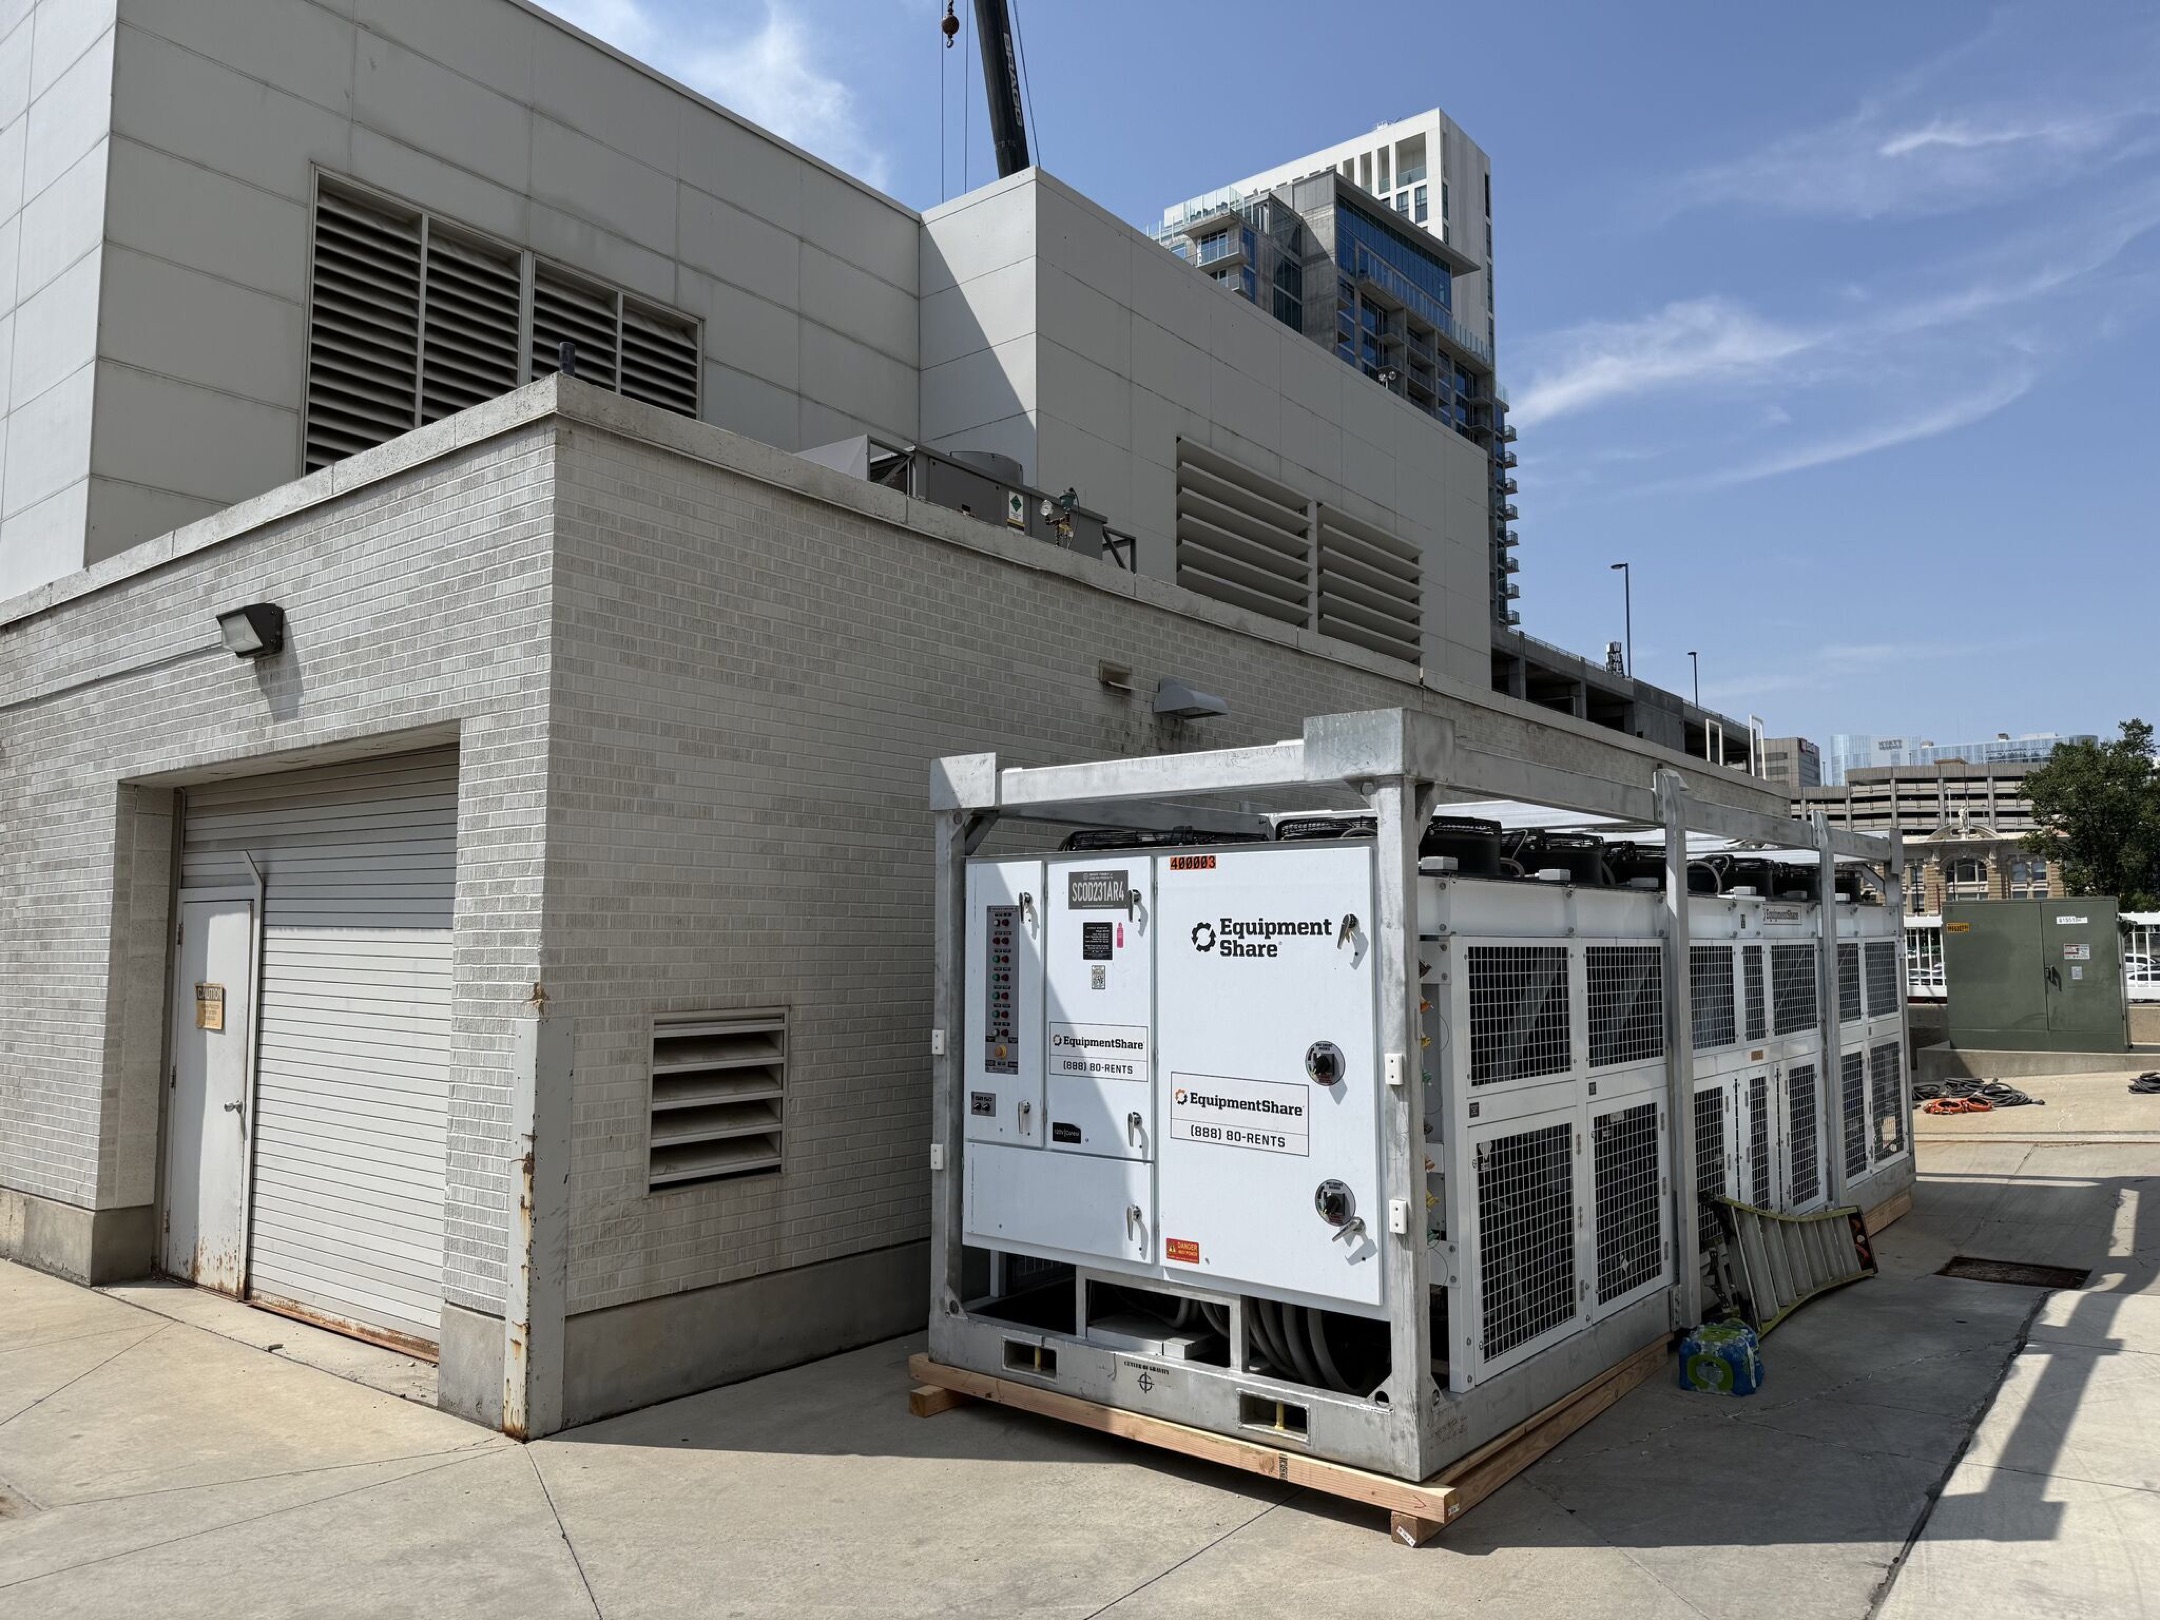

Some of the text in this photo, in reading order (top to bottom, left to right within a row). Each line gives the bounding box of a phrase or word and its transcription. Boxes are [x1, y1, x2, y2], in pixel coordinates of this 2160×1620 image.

[1003, 33, 1022, 127] BRAGG
[1170, 855, 1216, 869] 400003
[1220, 918, 1332, 939] Equipment
[1220, 940, 1278, 957] Share
[198, 987, 222, 1000] CAUTION
[1063, 1036, 1144, 1050] EquipmentShare
[1063, 1060, 1133, 1075] (888) 80-RENTS
[1190, 1092, 1303, 1117] EquipmentShare
[1190, 1124, 1286, 1148] (888) 80-RENTS
